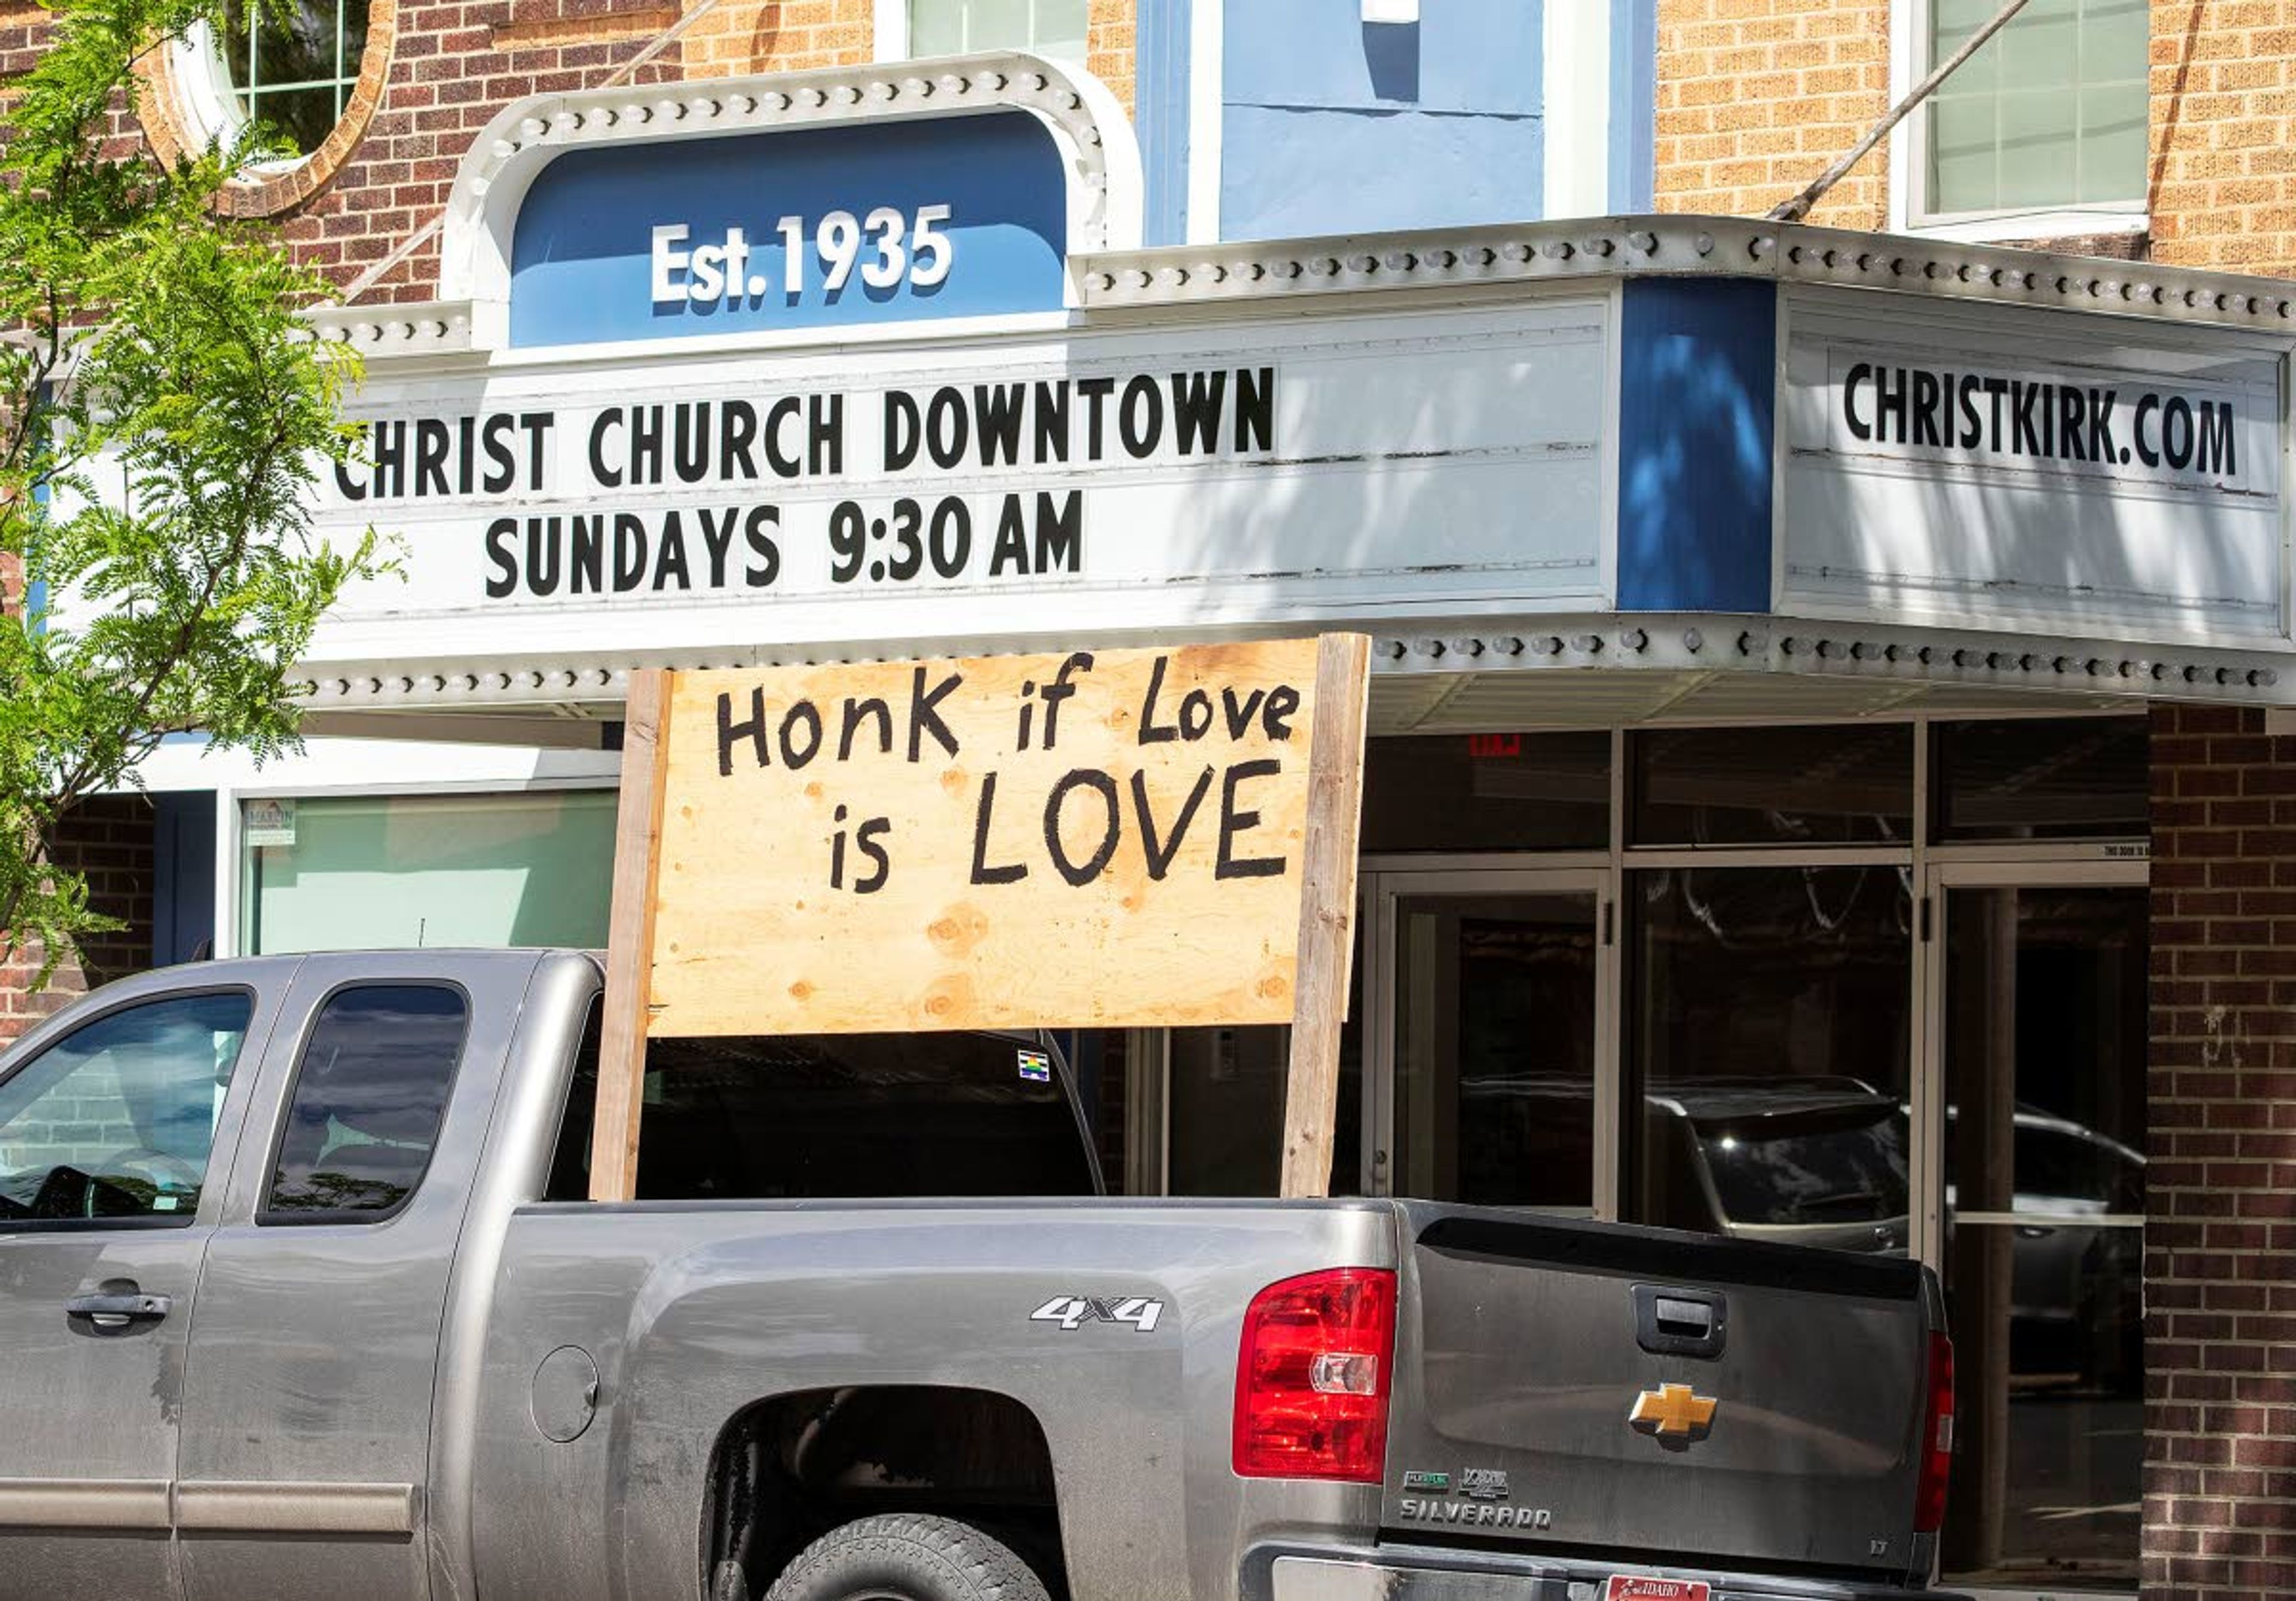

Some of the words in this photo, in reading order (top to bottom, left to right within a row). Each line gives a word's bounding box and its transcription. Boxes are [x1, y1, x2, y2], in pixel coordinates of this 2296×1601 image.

[335, 411, 554, 501] CHRIST
[589, 393, 843, 488] CHURCH
[884, 367, 1274, 472] DOWNTOWN
[1843, 362, 2237, 476] CHRISTKIRK.COM
[485, 505, 780, 598] SUNDAYS
[829, 494, 972, 583] 9:30
[988, 489, 1083, 576] AM
[1016, 652, 1095, 751] if
[1138, 655, 1300, 746] Love
[831, 803, 891, 894] is
[970, 759, 1287, 887] LOVE
[1400, 1499, 1552, 1527] SILVERADO
[1643, 1582, 1680, 1597] IDAHO
